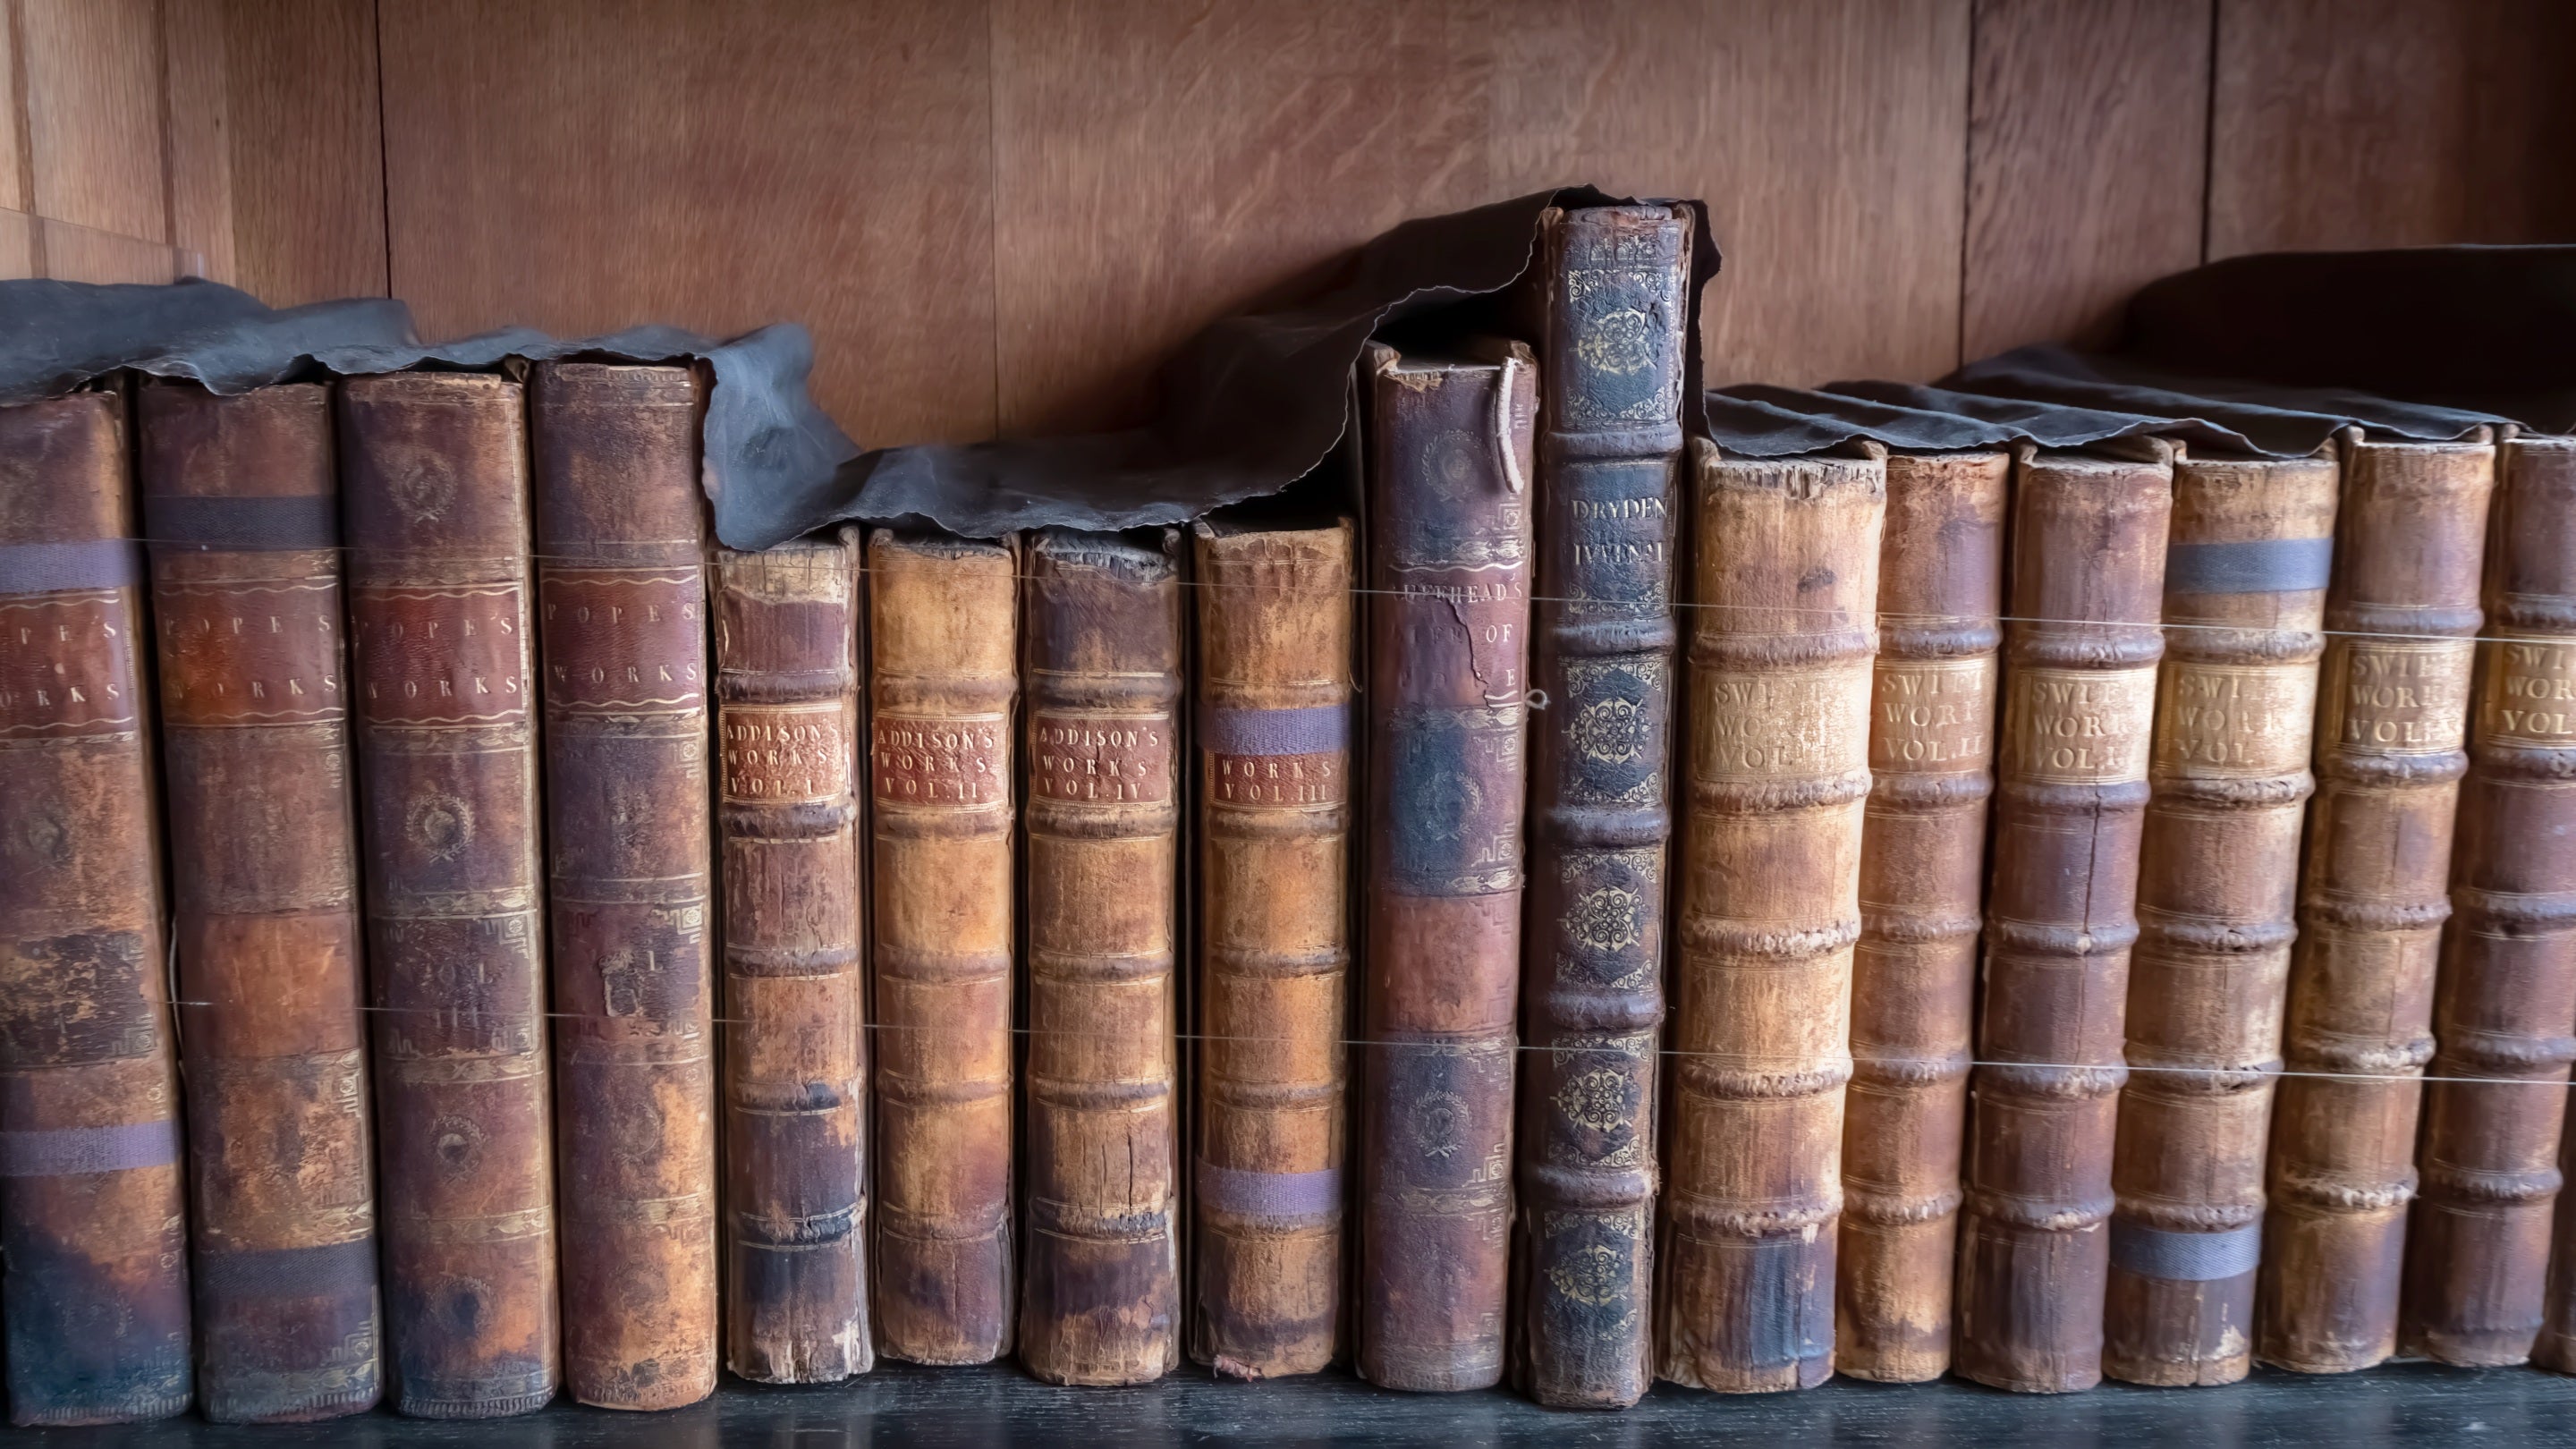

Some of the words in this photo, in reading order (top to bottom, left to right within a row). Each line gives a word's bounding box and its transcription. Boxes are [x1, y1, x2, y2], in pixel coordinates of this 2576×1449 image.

[1572, 497, 1667, 519] DRYDEN
[1486, 623, 1513, 643] OF
[554, 662, 698, 684] WORKS
[367, 675, 518, 699] WORKS
[728, 750, 827, 766] WORKS
[880, 751, 987, 773] WORKS
[1043, 754, 1148, 777] WORKS
[1223, 759, 1331, 779] WORKS
[1298, 784, 1326, 802] III
